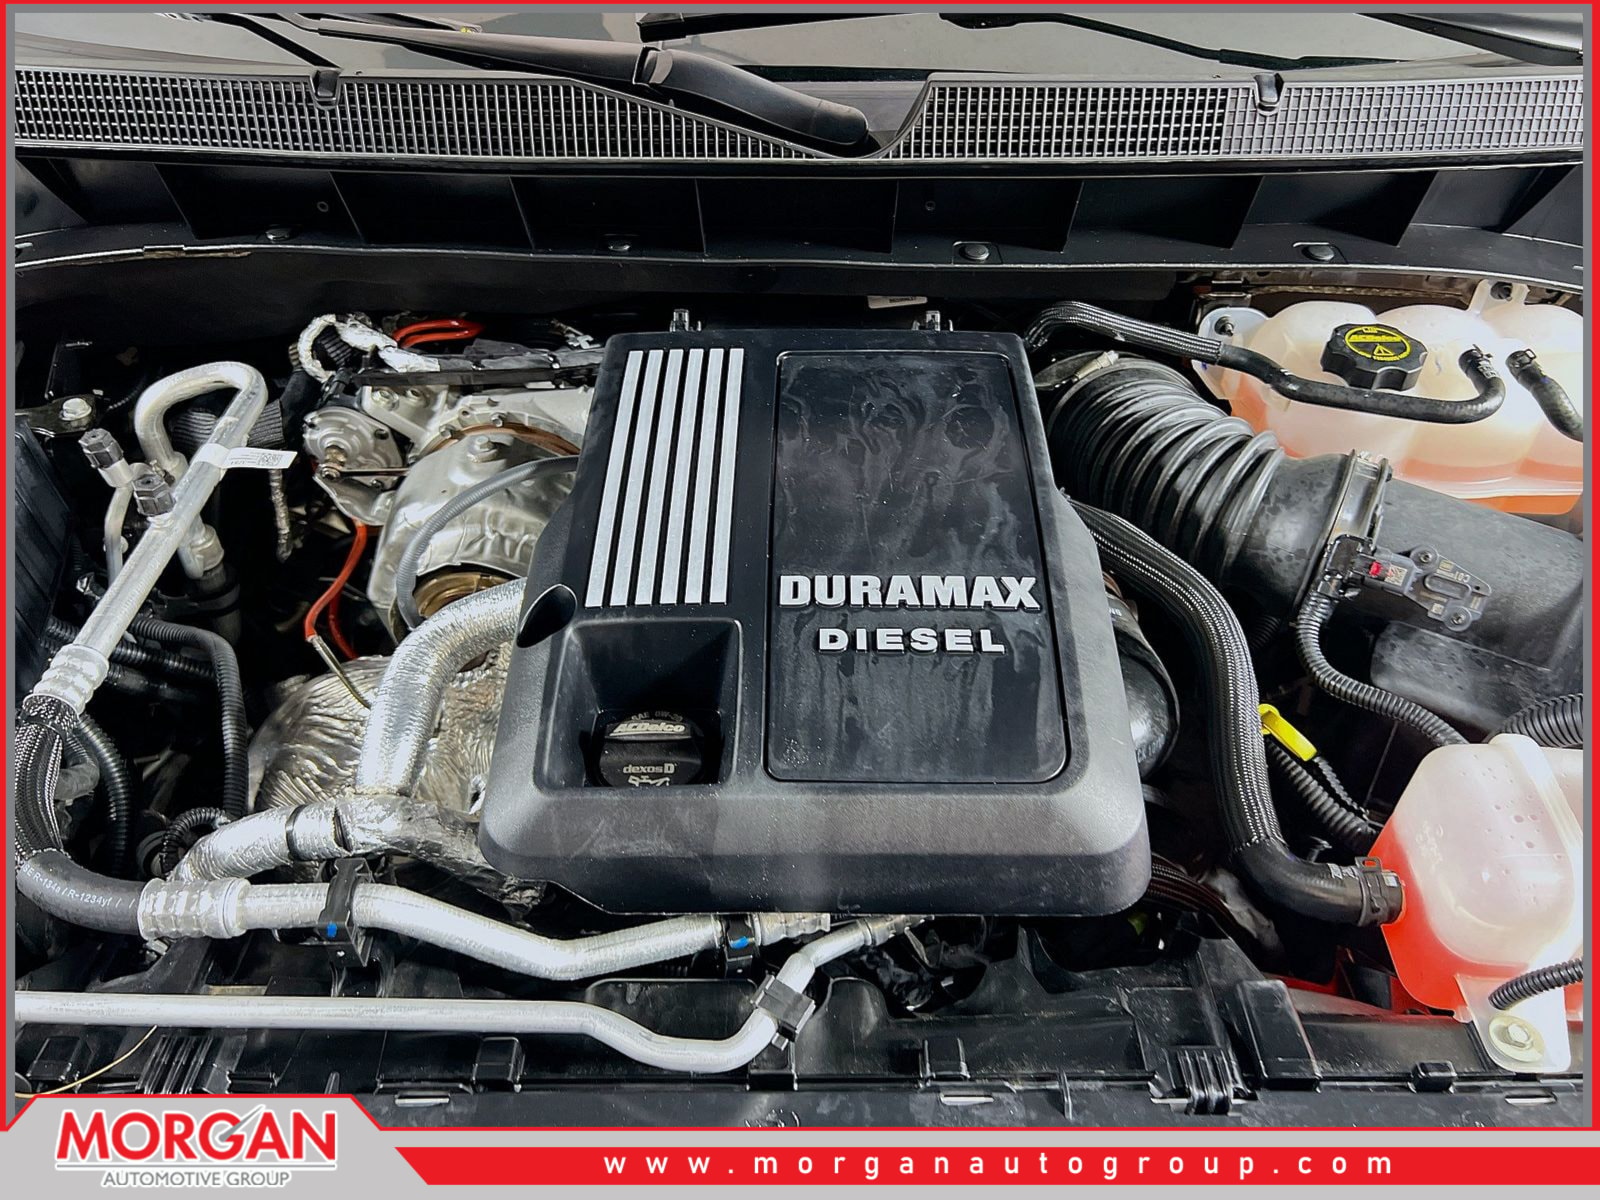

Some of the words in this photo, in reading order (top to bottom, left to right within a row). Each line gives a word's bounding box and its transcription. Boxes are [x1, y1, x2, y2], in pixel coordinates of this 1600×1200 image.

[779, 575, 1040, 610] DURAMAX
[818, 628, 1005, 654] DIESEL
[611, 722, 686, 734] ACDelco
[631, 711, 650, 721] SAE
[33, 873, 61, 894] R-134a
[67, 889, 113, 908] R-1234yf
